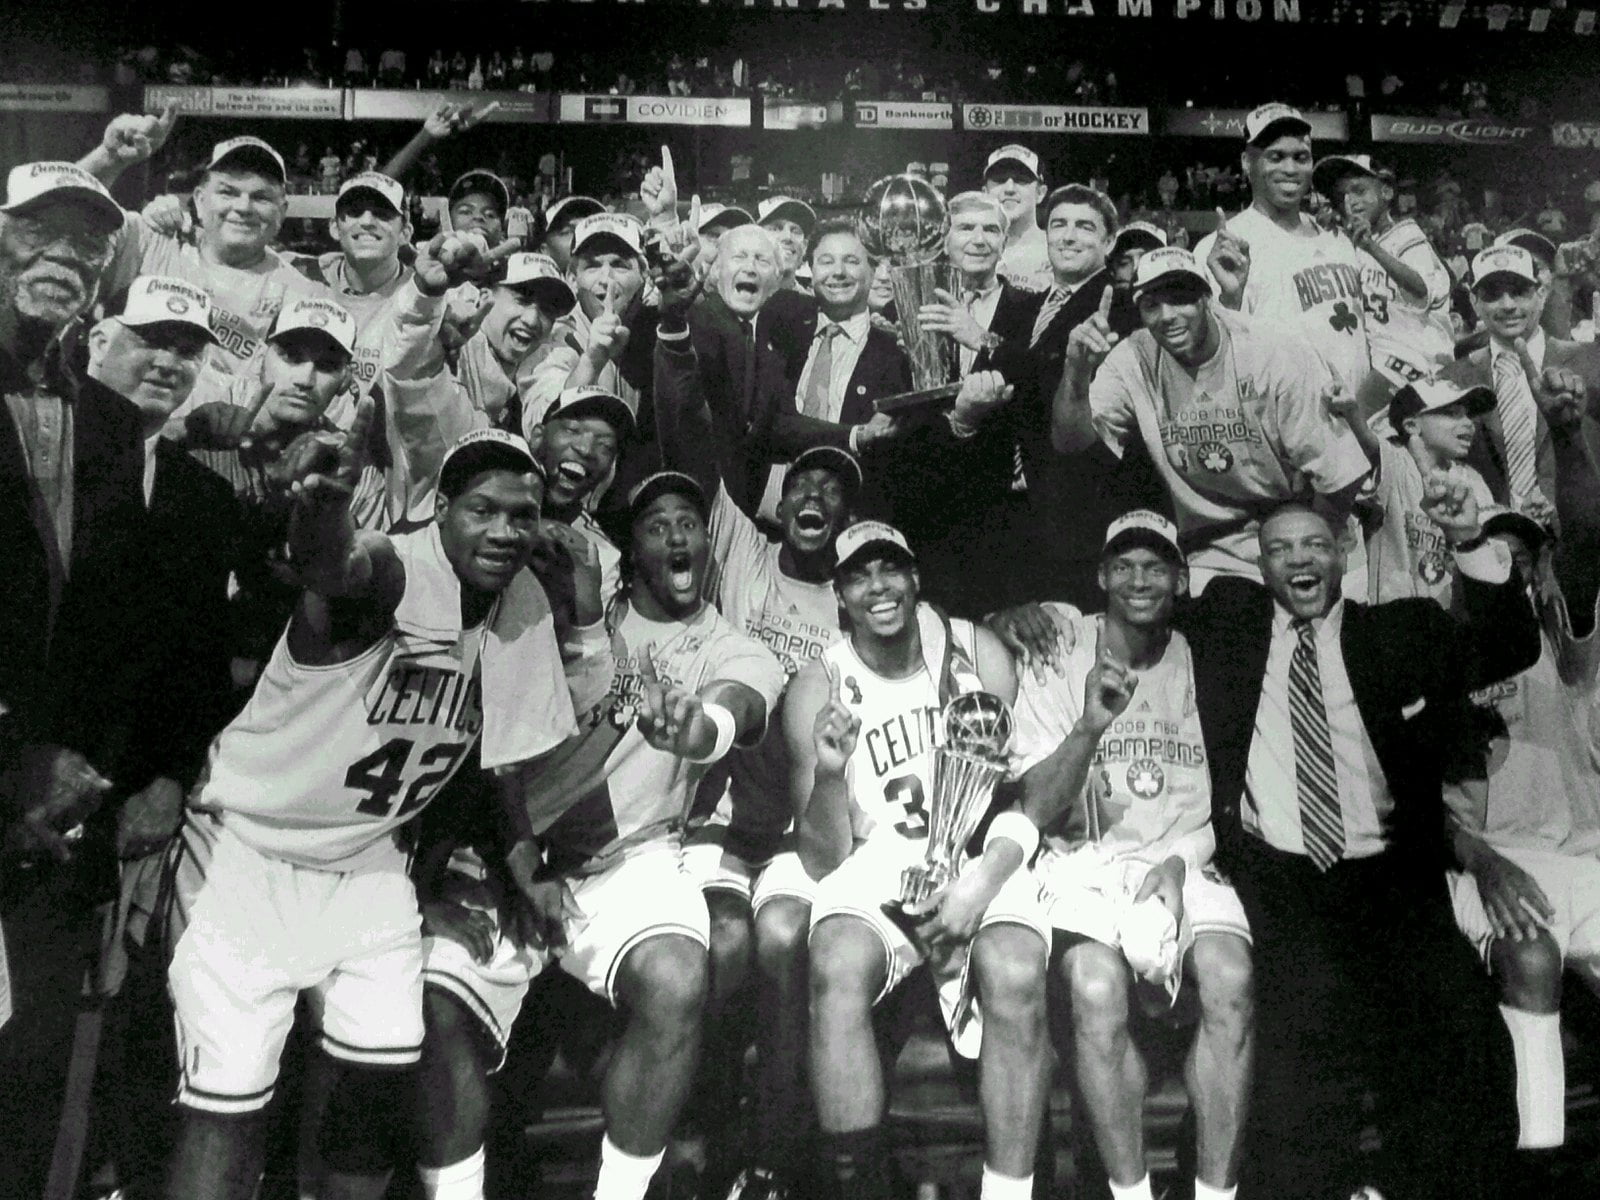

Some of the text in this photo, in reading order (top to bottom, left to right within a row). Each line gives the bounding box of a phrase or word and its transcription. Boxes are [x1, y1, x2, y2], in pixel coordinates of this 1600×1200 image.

[638, 103, 729, 119] COVIDIEN
[1064, 112, 1142, 129] HOCKEY
[1390, 122, 1532, 137] BUD LIGHT
[1293, 263, 1362, 312] BOSTO
[367, 667, 482, 737] CELTICS
[1094, 738, 1205, 766] HAMPIONS
[343, 737, 467, 818] 42
